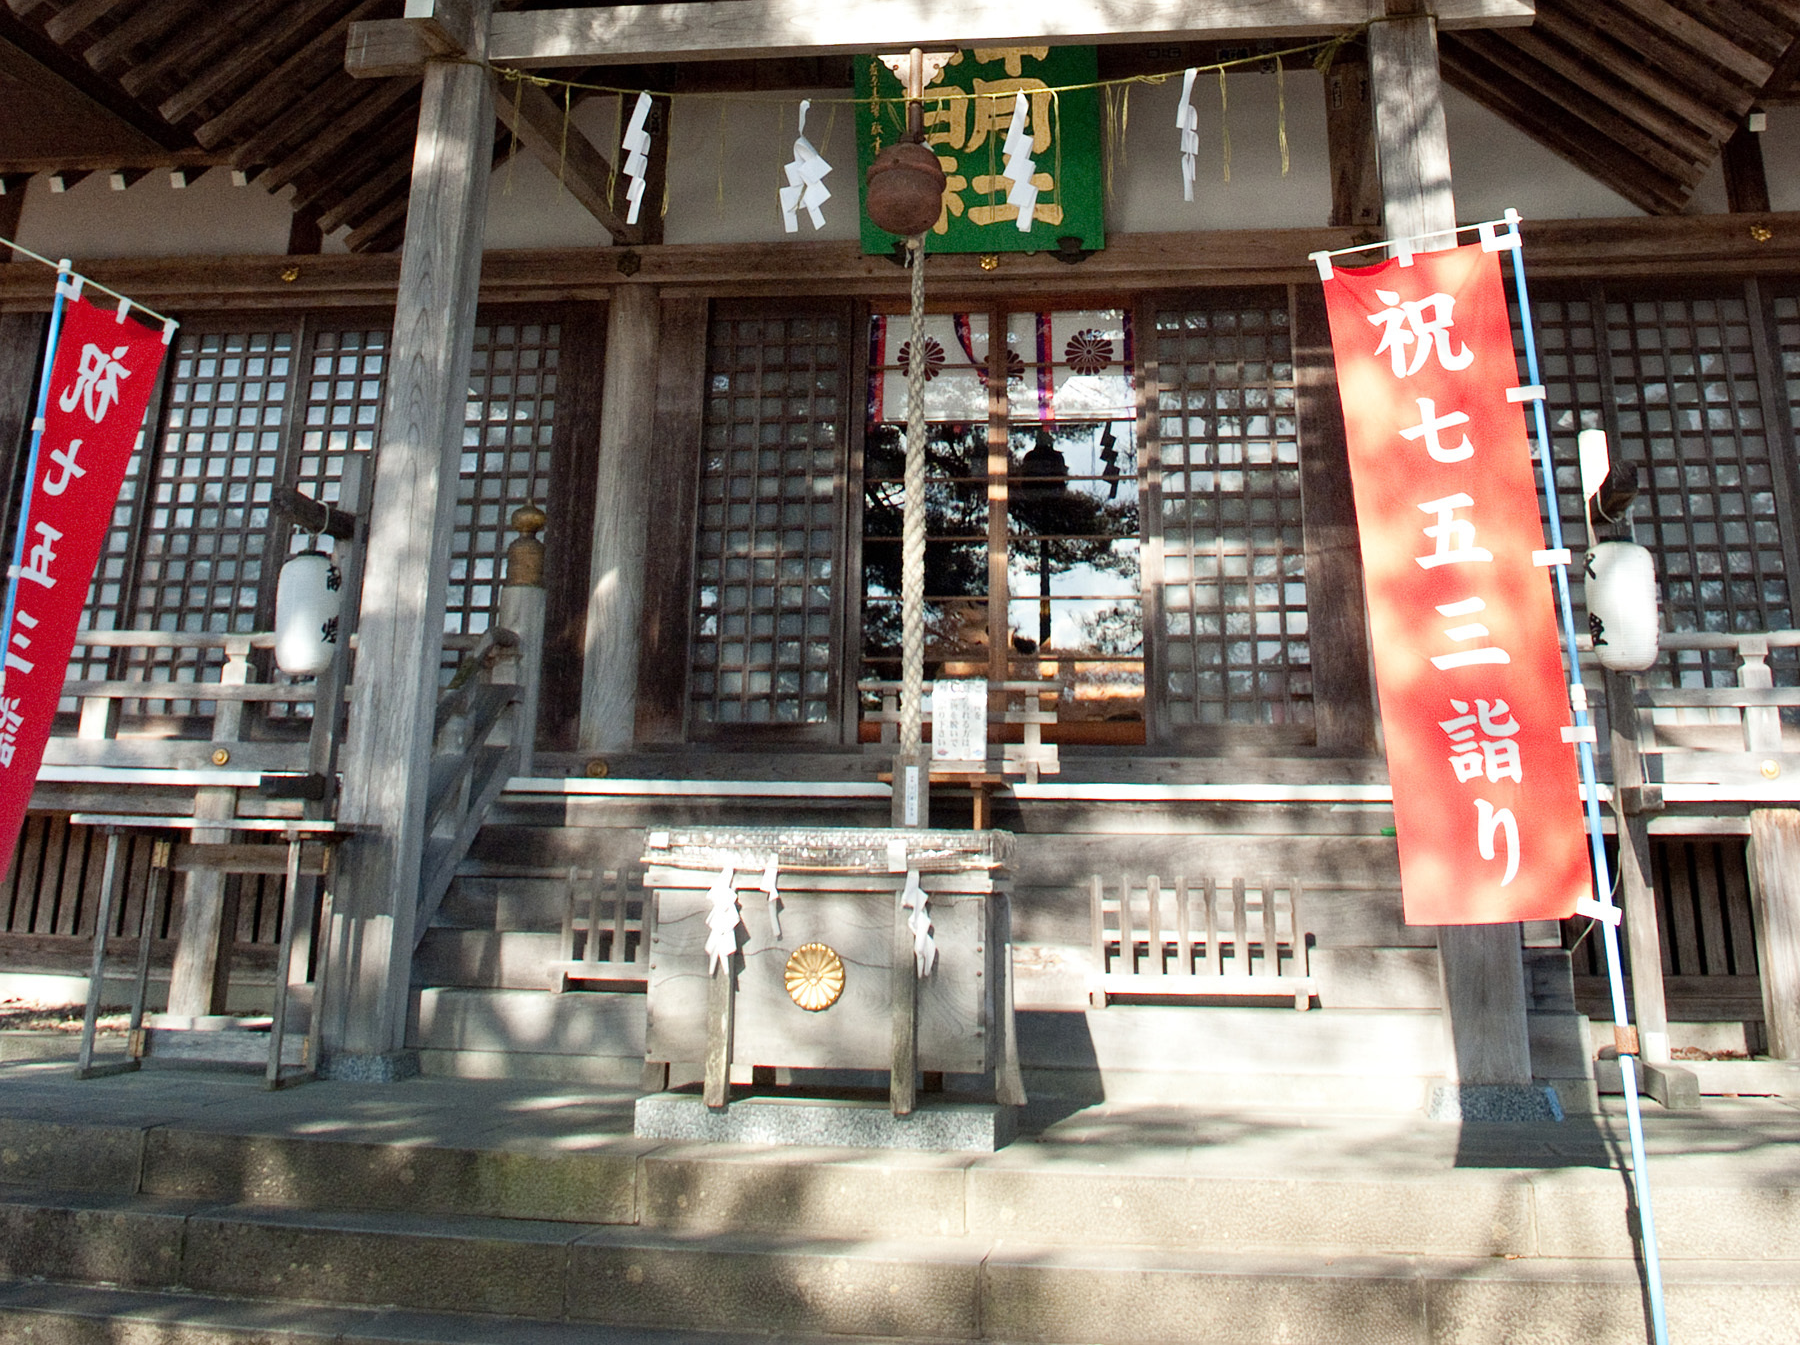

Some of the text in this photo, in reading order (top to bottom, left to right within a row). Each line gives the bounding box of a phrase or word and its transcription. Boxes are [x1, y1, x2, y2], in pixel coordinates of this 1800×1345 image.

[1366, 288, 1524, 888] 祝七五三詣り
